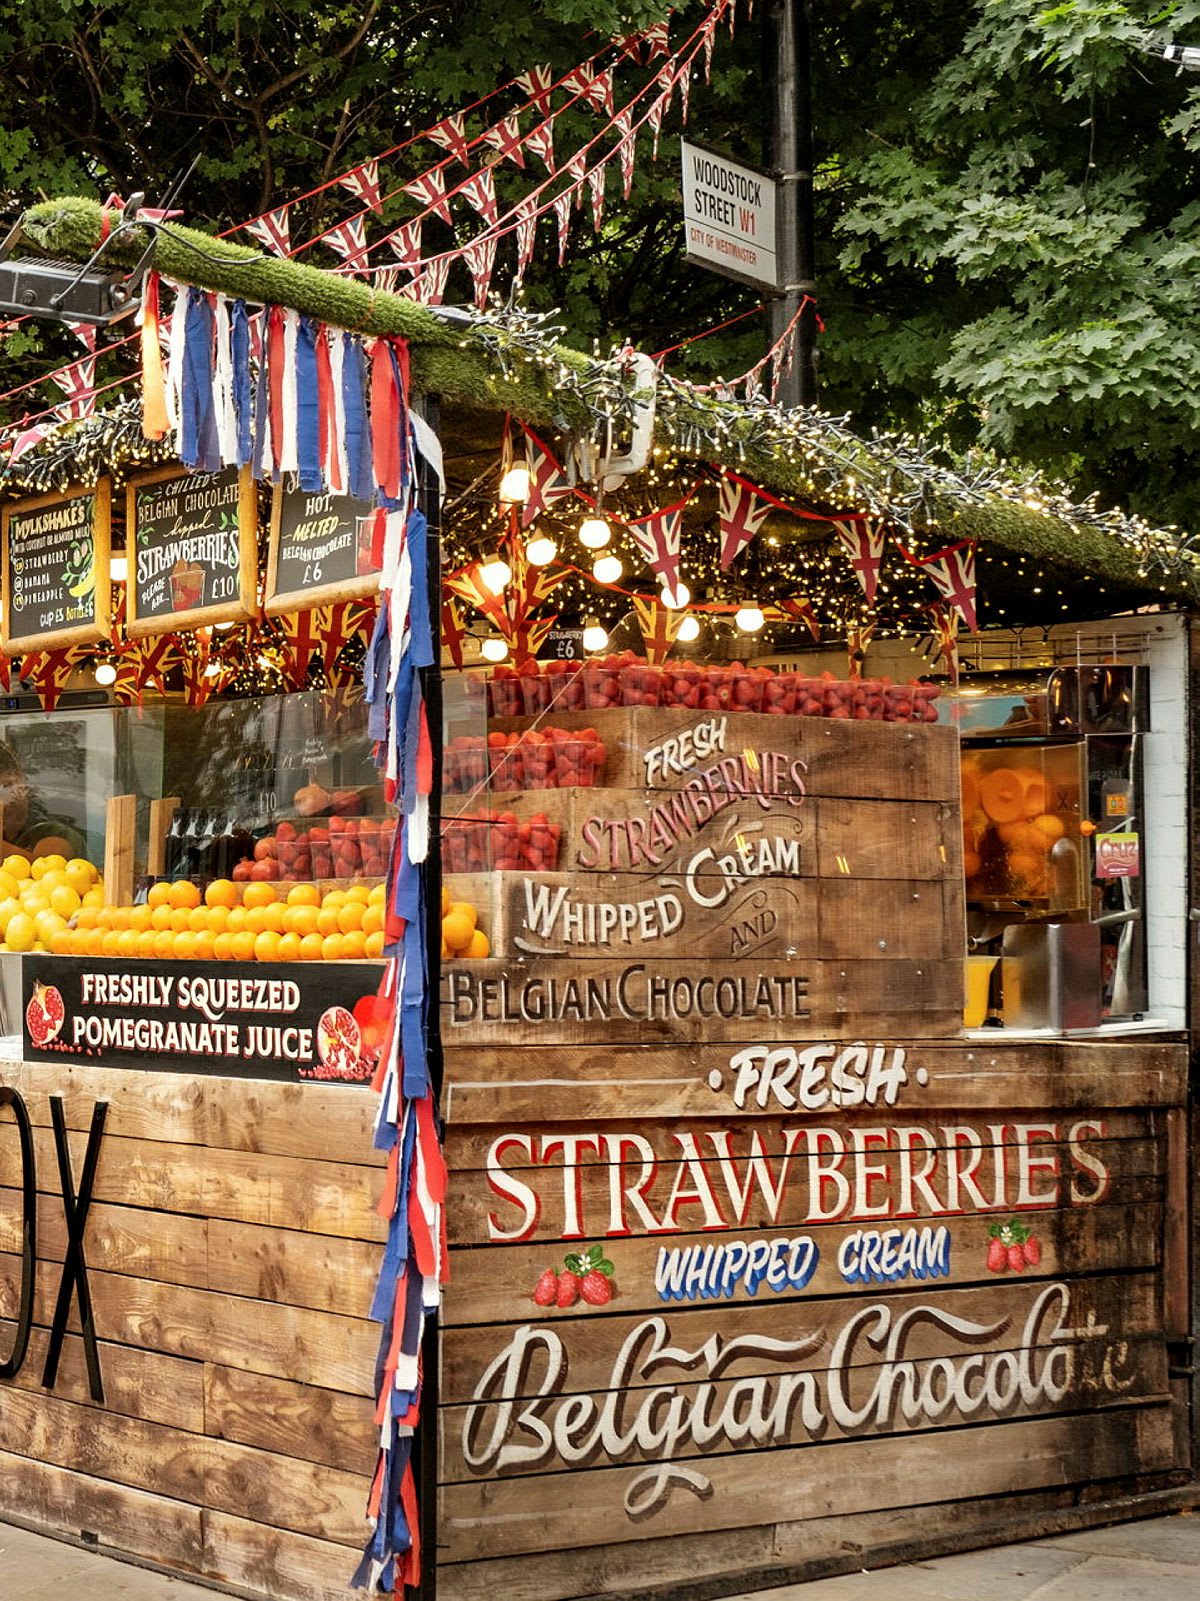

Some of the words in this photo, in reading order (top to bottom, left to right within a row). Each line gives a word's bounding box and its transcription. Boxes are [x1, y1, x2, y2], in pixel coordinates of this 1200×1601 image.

[693, 156, 762, 208] WOODSTOCK
[695, 188, 736, 228] STREET
[738, 207, 755, 236] W1
[690, 227, 704, 243] CITY
[706, 234, 714, 247] OF
[715, 238, 757, 265] WESTMINSTER
[138, 498, 178, 524] BELGIAN
[184, 484, 240, 512] CHOCOLATE
[166, 474, 210, 496] CHILLED
[15, 505, 85, 540] MYLKSHAKES
[26, 538, 46, 551] COCONUT
[47, 536, 53, 546] OR
[54, 530, 73, 544] ALMOND
[292, 516, 339, 542] MELTED
[25, 549, 68, 570] STRAWBERRY
[137, 530, 240, 584] STRAWBERRIES
[282, 546, 312, 562] BELGIAN
[312, 533, 352, 560] CHOCOLATE
[24, 573, 50, 589] BANANA
[142, 576, 166, 604] PLEASE
[212, 576, 234, 599] £10
[302, 562, 322, 584] £6
[24, 588, 64, 606] PINEAPPLE
[40, 612, 54, 627] CUP
[56, 608, 64, 622] £5
[556, 640, 575, 658] £6
[644, 716, 728, 787] FRESH
[577, 750, 808, 872] STRAWBERRIES
[523, 876, 683, 946] WHIPPED
[685, 837, 800, 909] CREAM
[728, 909, 777, 955] AND
[80, 973, 174, 1006] FRESHLY
[178, 976, 300, 1022] SQUEEZED
[449, 968, 612, 1026] BELGIAN
[616, 964, 811, 1022] CHOCOLATE
[72, 1016, 239, 1053] POMEGRANATE
[244, 1026, 313, 1062] JUICE
[728, 1044, 906, 1110] FRESH
[486, 1120, 1111, 1242] STRAWBERRIES
[654, 1235, 819, 1301] WHIPPED
[838, 1226, 952, 1284] CREAM
[462, 1316, 828, 1517] Belgian
[826, 1282, 1135, 1430] Chocolate
